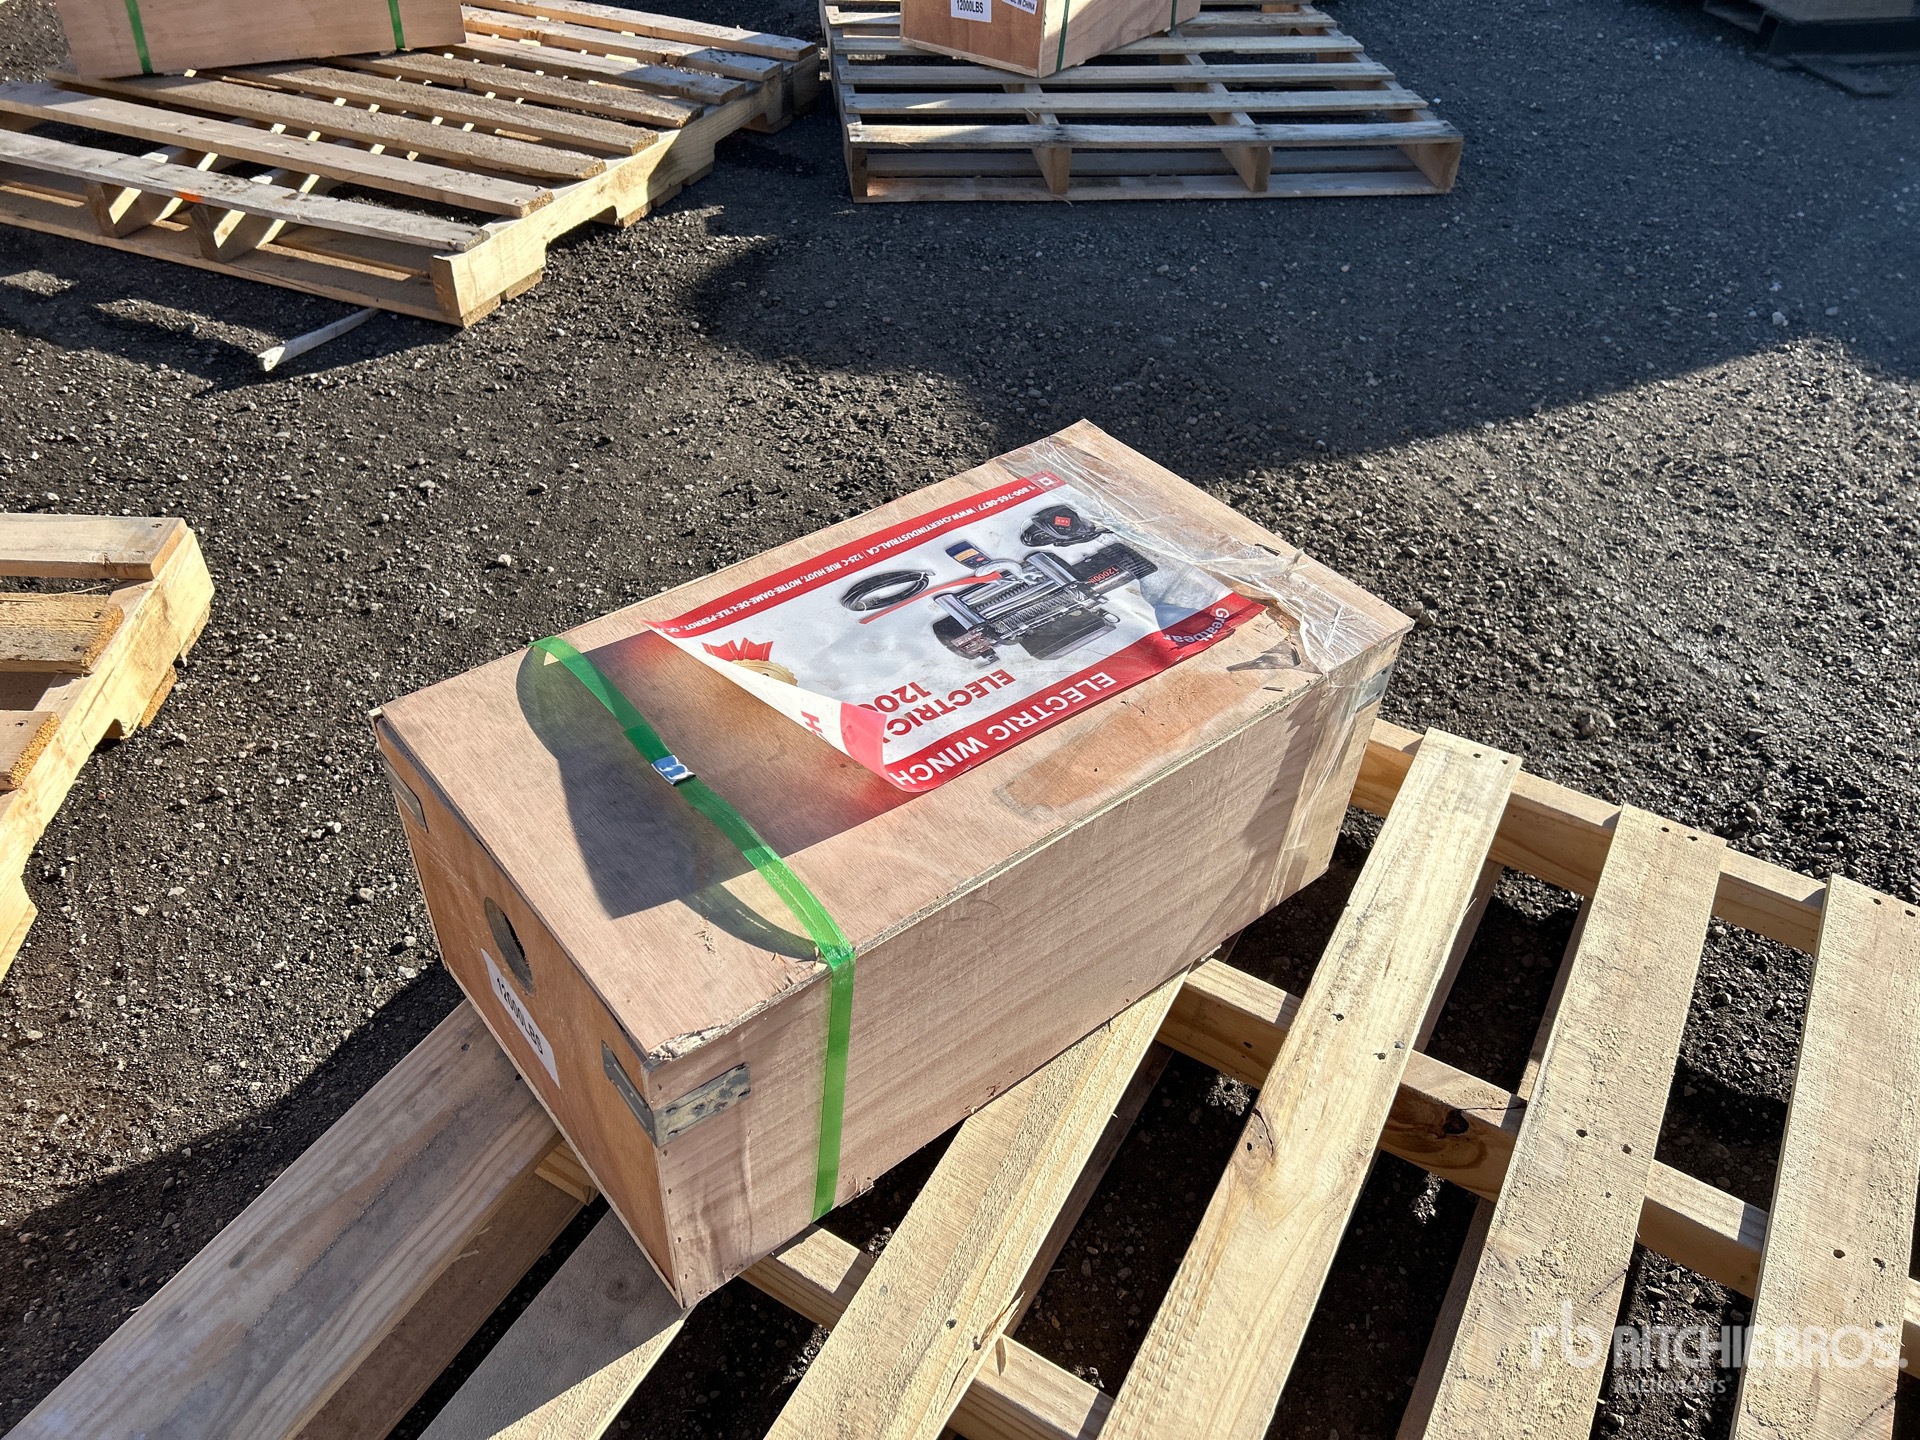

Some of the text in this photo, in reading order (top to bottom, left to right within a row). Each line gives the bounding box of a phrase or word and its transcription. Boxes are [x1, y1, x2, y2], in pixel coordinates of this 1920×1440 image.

[957, 0, 984, 13] 12000LBS
[977, 487, 1030, 512] 800-765-0877
[1028, 485, 1036, 494] 1
[866, 508, 975, 556] WWW.CHERYINDUSTRIAL.CA
[826, 562, 842, 574] RUE
[843, 552, 864, 568] 125-C
[799, 568, 827, 583] HUOT,
[1163, 607, 1230, 644] Greatbear
[886, 668, 1016, 735] ELECTRIC
[888, 671, 1117, 786] ELECTRIC WINCH
